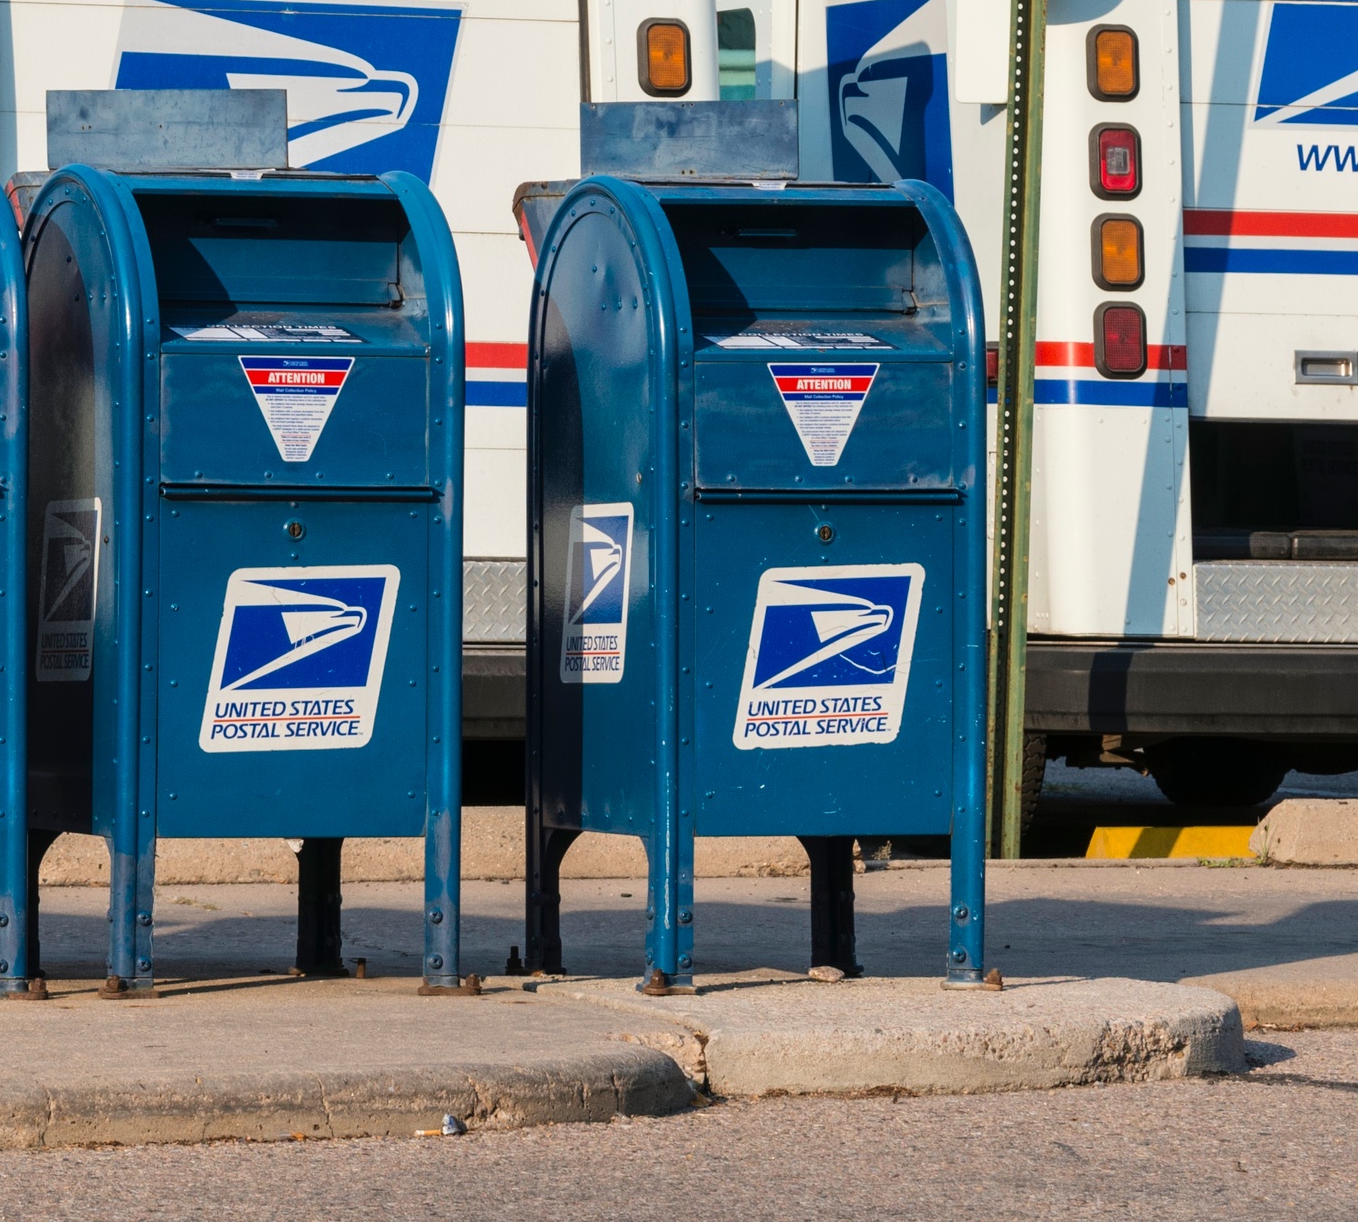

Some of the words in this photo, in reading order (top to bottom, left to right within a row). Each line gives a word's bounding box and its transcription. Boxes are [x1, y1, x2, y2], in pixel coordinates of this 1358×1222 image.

[268, 372, 325, 384] ATTENTION
[796, 378, 852, 390] ATTENTION
[566, 636, 593, 651] UNITED
[593, 635, 618, 650] STATES
[565, 656, 590, 672] POSTAL
[592, 656, 620, 671] SERVICE
[214, 701, 286, 718] UNITED
[288, 699, 354, 716] STATES
[748, 699, 816, 717] UNITED
[818, 696, 882, 713] STATES
[210, 723, 280, 740] POSTAL
[744, 720, 812, 738] POSTAL
